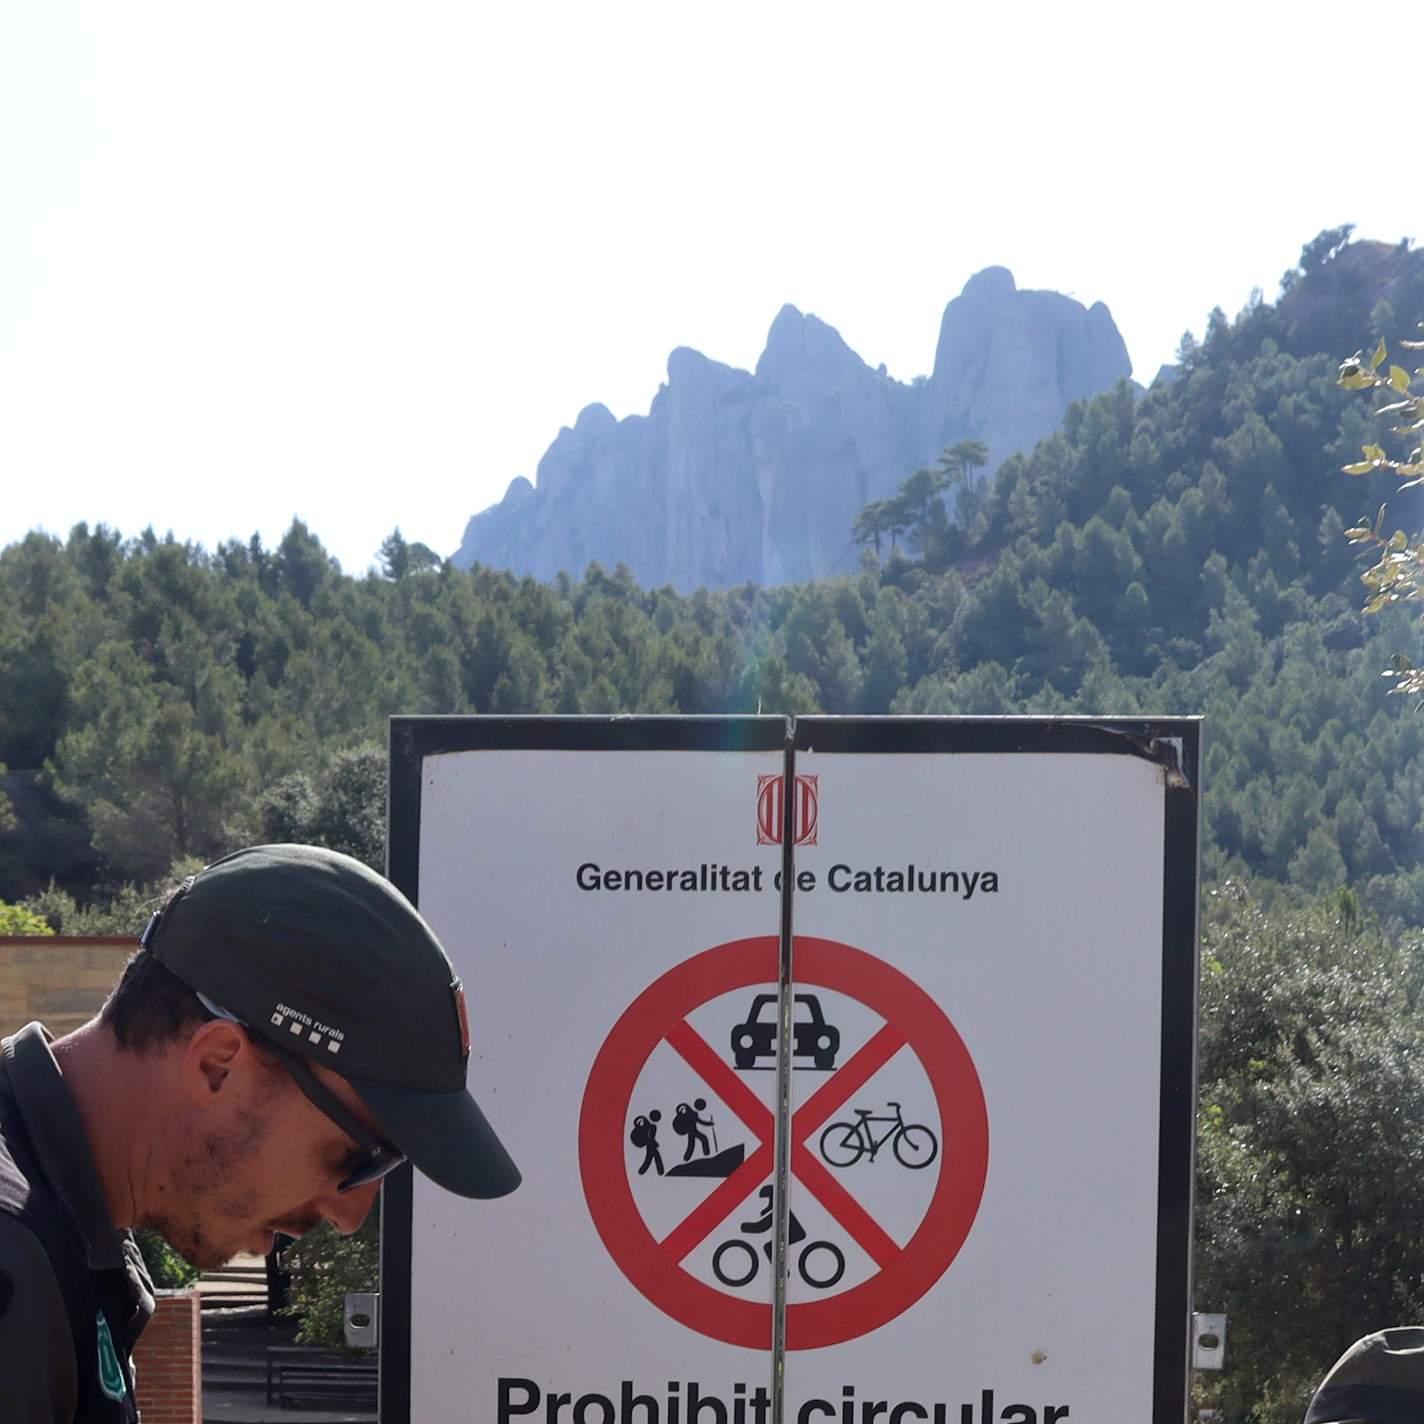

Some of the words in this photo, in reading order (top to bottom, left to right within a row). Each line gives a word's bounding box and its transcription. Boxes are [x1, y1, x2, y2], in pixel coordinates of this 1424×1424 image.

[576, 864, 763, 894] Generalitat
[827, 865, 1000, 900] Catalunya
[276, 1003, 312, 1025] agents
[313, 1022, 344, 1040] rurals
